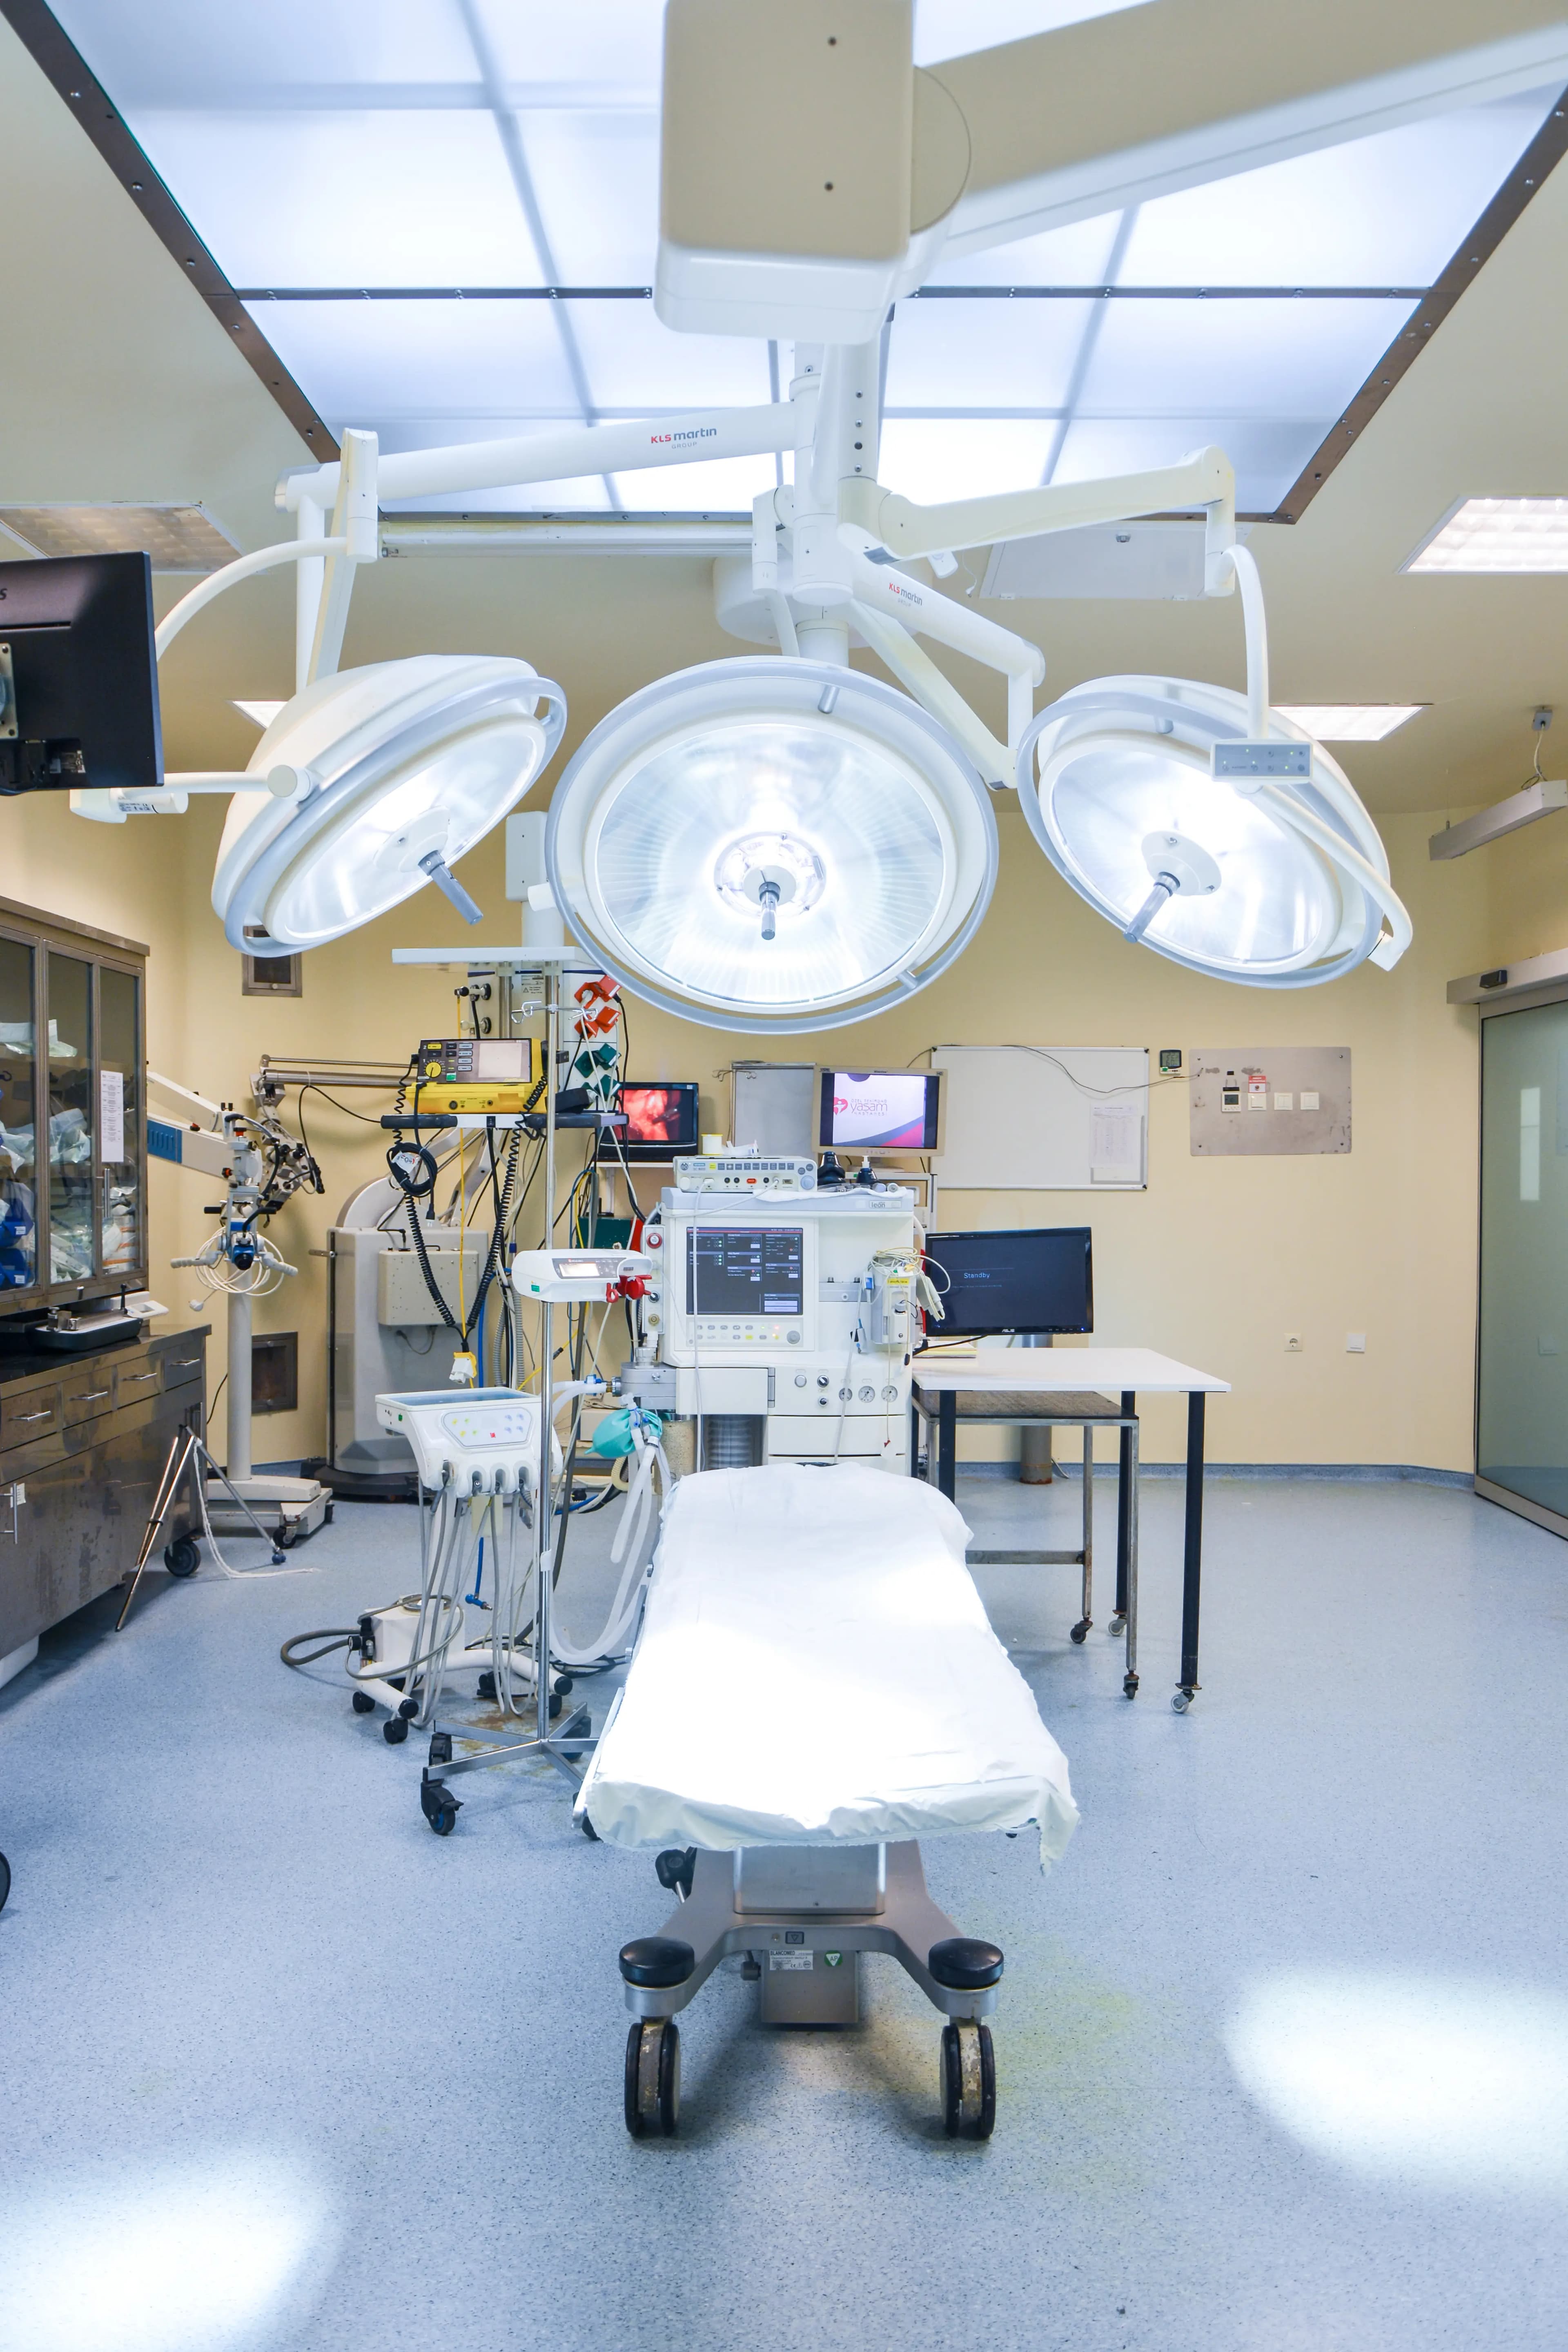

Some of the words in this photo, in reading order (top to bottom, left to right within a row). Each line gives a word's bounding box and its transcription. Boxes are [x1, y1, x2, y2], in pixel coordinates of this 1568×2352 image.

[651, 434, 671, 443] KLS
[674, 428, 717, 441] martin
[889, 582, 900, 594] KLS
[901, 589, 922, 606] martin
